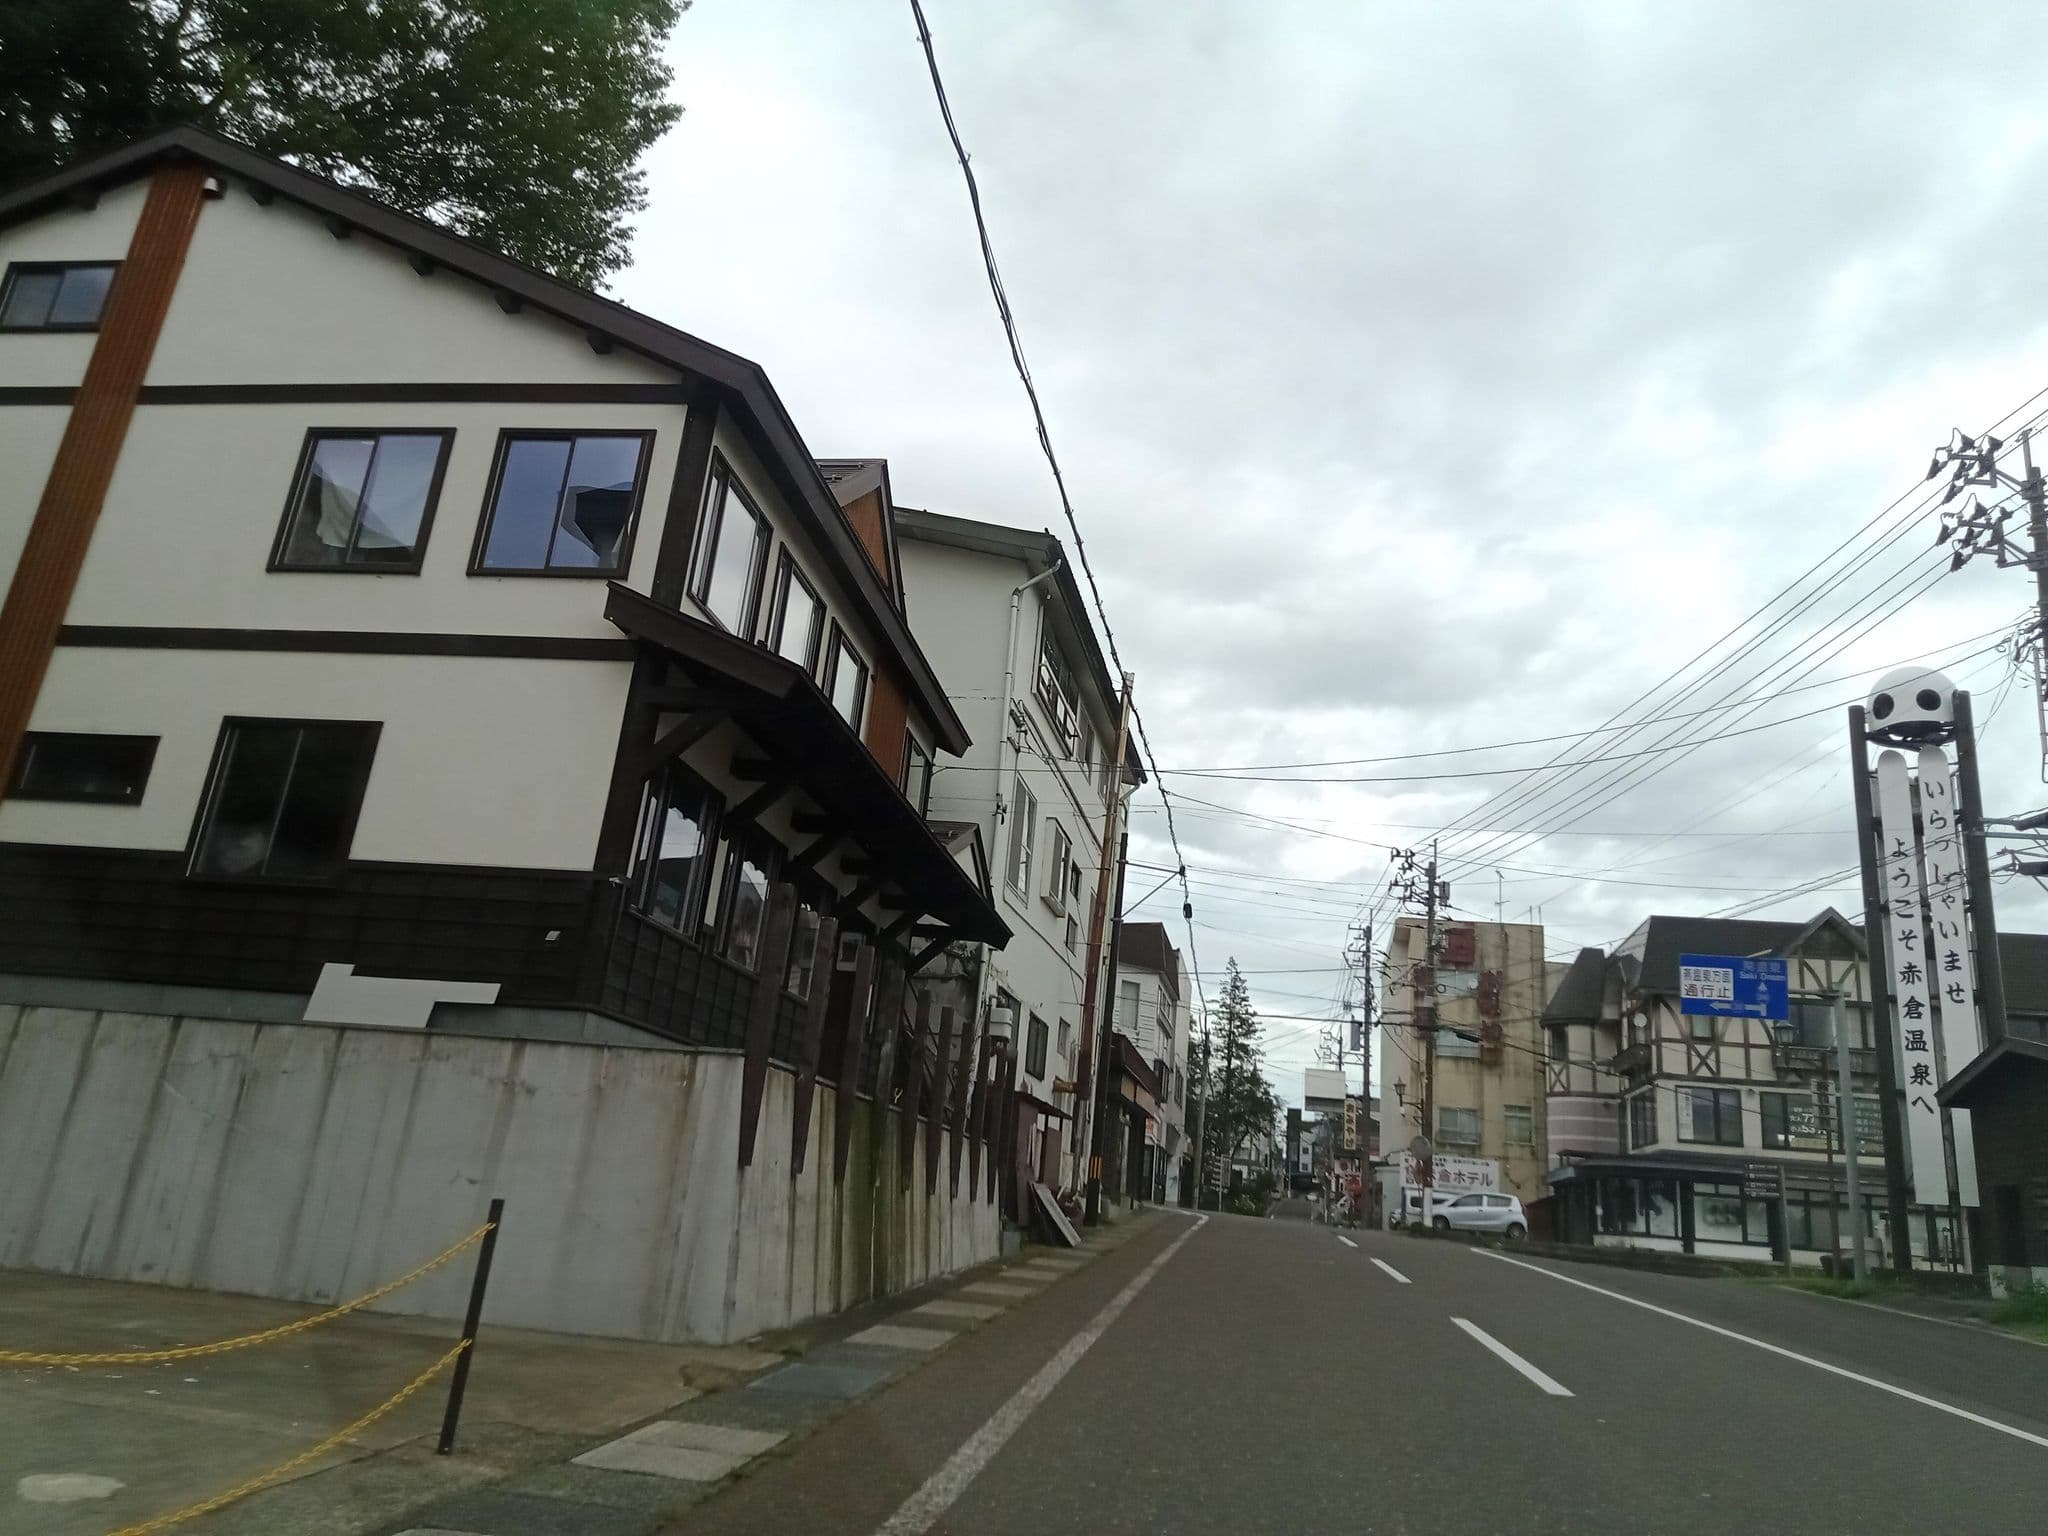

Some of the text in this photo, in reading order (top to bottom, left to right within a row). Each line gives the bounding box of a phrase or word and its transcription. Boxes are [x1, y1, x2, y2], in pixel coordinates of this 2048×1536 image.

[1684, 983, 1730, 998] 通行止
[1890, 836, 1936, 1115] ようこそ赤倉温泉へ
[1924, 780, 1966, 1005] いらっしゃいませ
